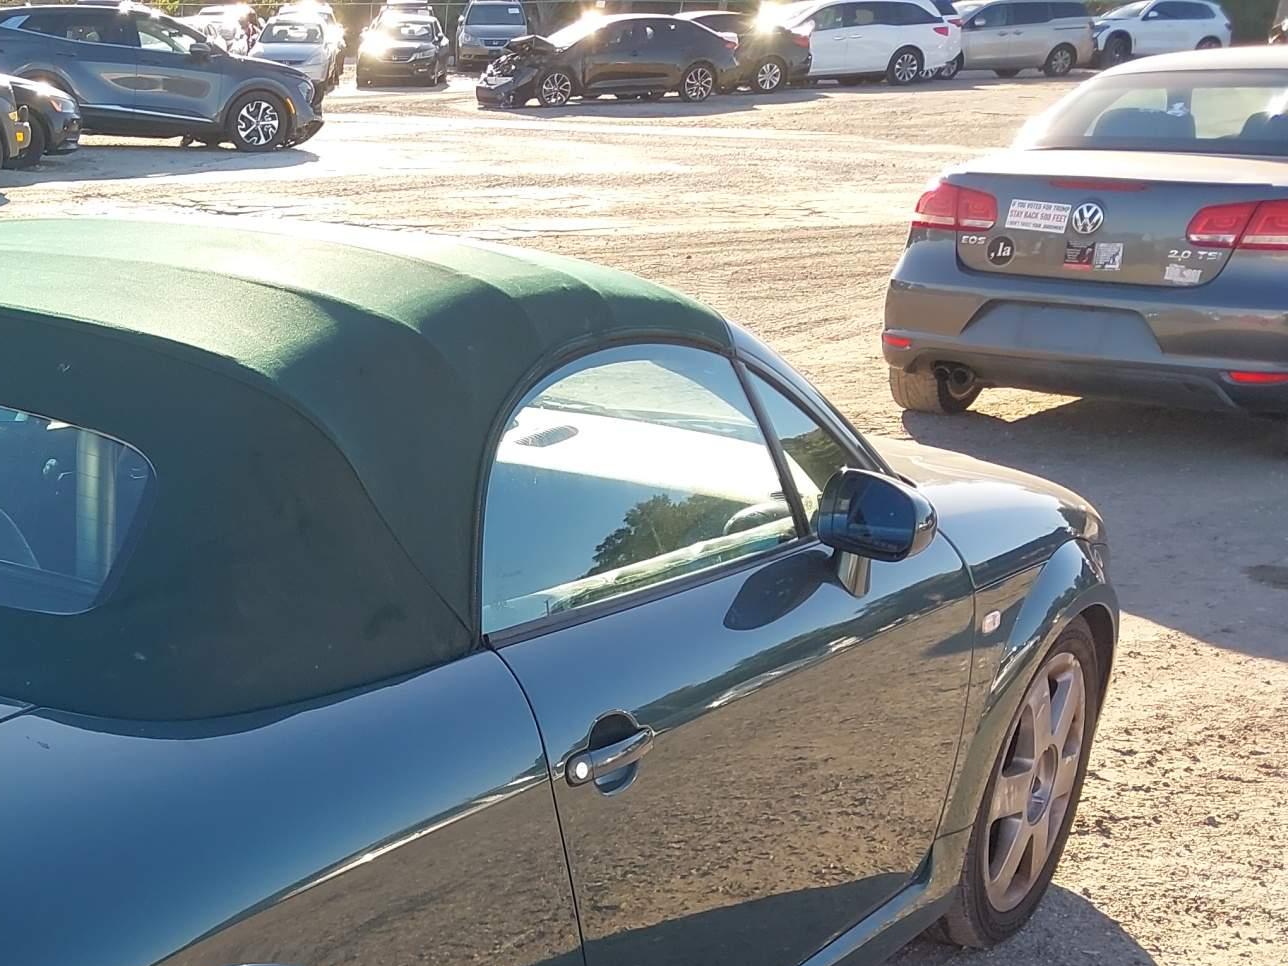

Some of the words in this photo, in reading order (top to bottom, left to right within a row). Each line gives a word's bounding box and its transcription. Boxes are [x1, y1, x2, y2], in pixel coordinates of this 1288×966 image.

[1027, 202, 1042, 210] VOTED
[1009, 210, 1023, 218] STAY
[1023, 211, 1039, 219] BACK
[1052, 214, 1067, 223] FEET
[961, 235, 987, 244] EOS
[1168, 249, 1192, 261] 2.0
